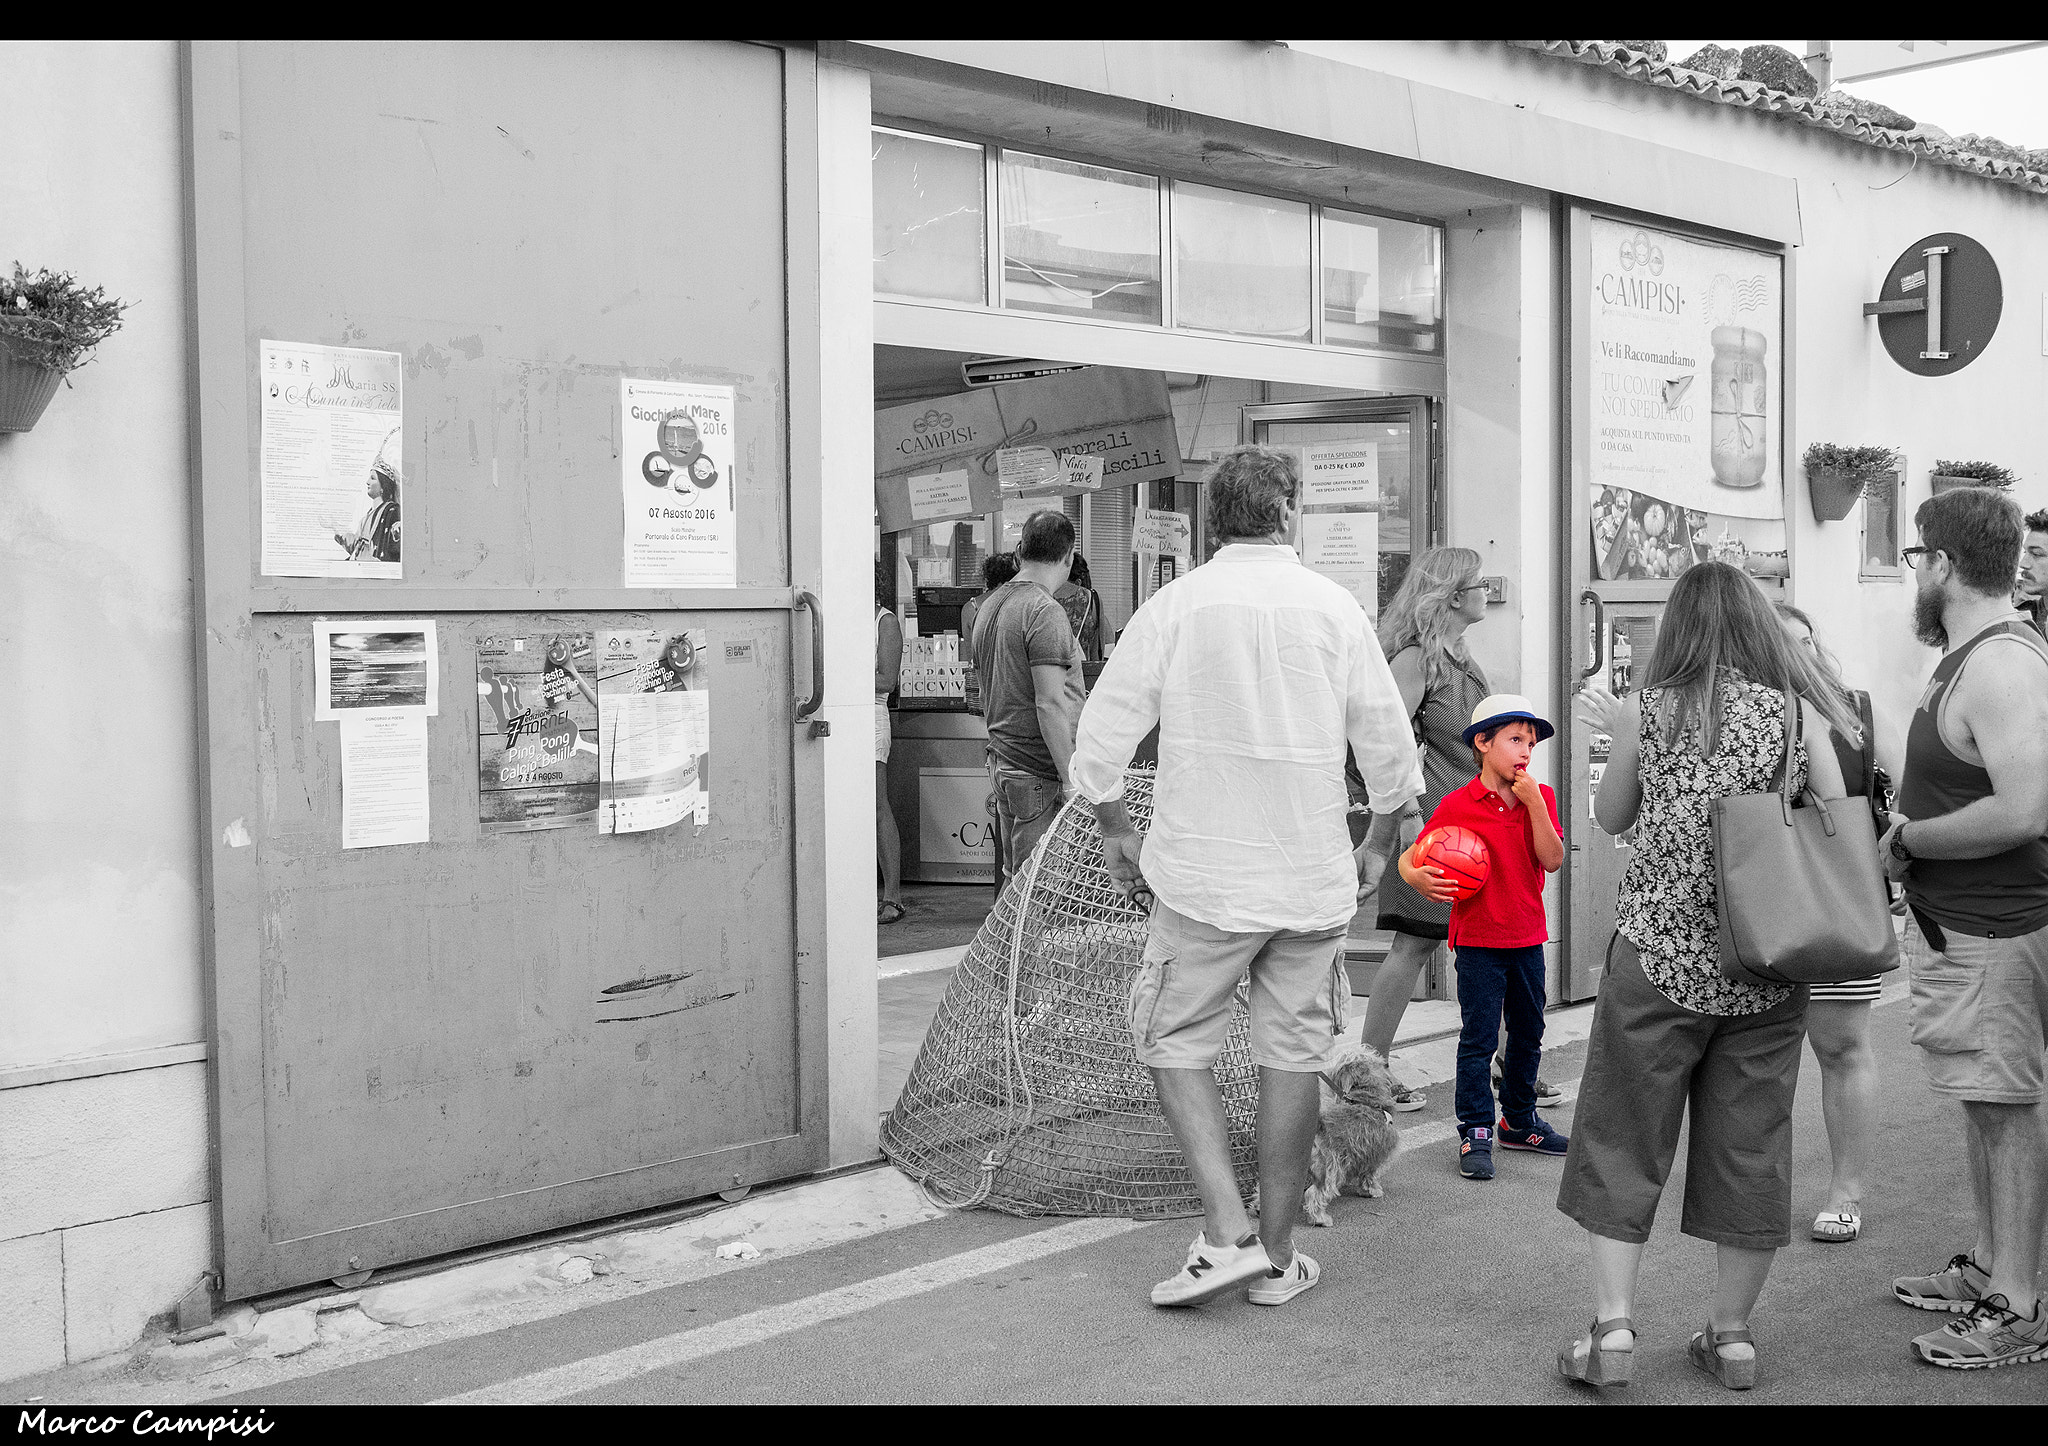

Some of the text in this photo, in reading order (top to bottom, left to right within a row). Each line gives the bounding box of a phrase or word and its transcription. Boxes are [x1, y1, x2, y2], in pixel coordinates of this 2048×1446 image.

[1601, 273, 1680, 315] CAMPISI
[1601, 341, 1613, 358] Ve
[1624, 344, 1696, 368] Raccomandiamo
[382, 381, 398, 394] SS.
[1602, 372, 1620, 393] TU
[285, 381, 347, 409] Assunta
[350, 396, 362, 408] in
[631, 405, 720, 422] Giochi del Mare
[1602, 396, 1626, 416] NOI
[703, 422, 728, 436] 2016
[1601, 427, 1631, 440] ACQUISTA
[1632, 430, 1643, 440] SUL
[1644, 431, 1665, 442] PUNTO
[901, 426, 973, 455] CAMPISI
[1310, 450, 1368, 461] OFFERTA SPEDIZIONE
[1070, 471, 1093, 484] 100 €
[648, 507, 716, 520] 07 Agosto 2016
[540, 667, 565, 684] Festa
[636, 660, 660, 675] Festa
[663, 670, 675, 683] IGP
[522, 709, 570, 736] TORNEI
[525, 708, 551, 723] edizione
[508, 732, 570, 763] Ping Pong
[500, 760, 538, 782] Calcio
[541, 745, 578, 768] Balilla
[538, 771, 563, 781] AGOSTO
